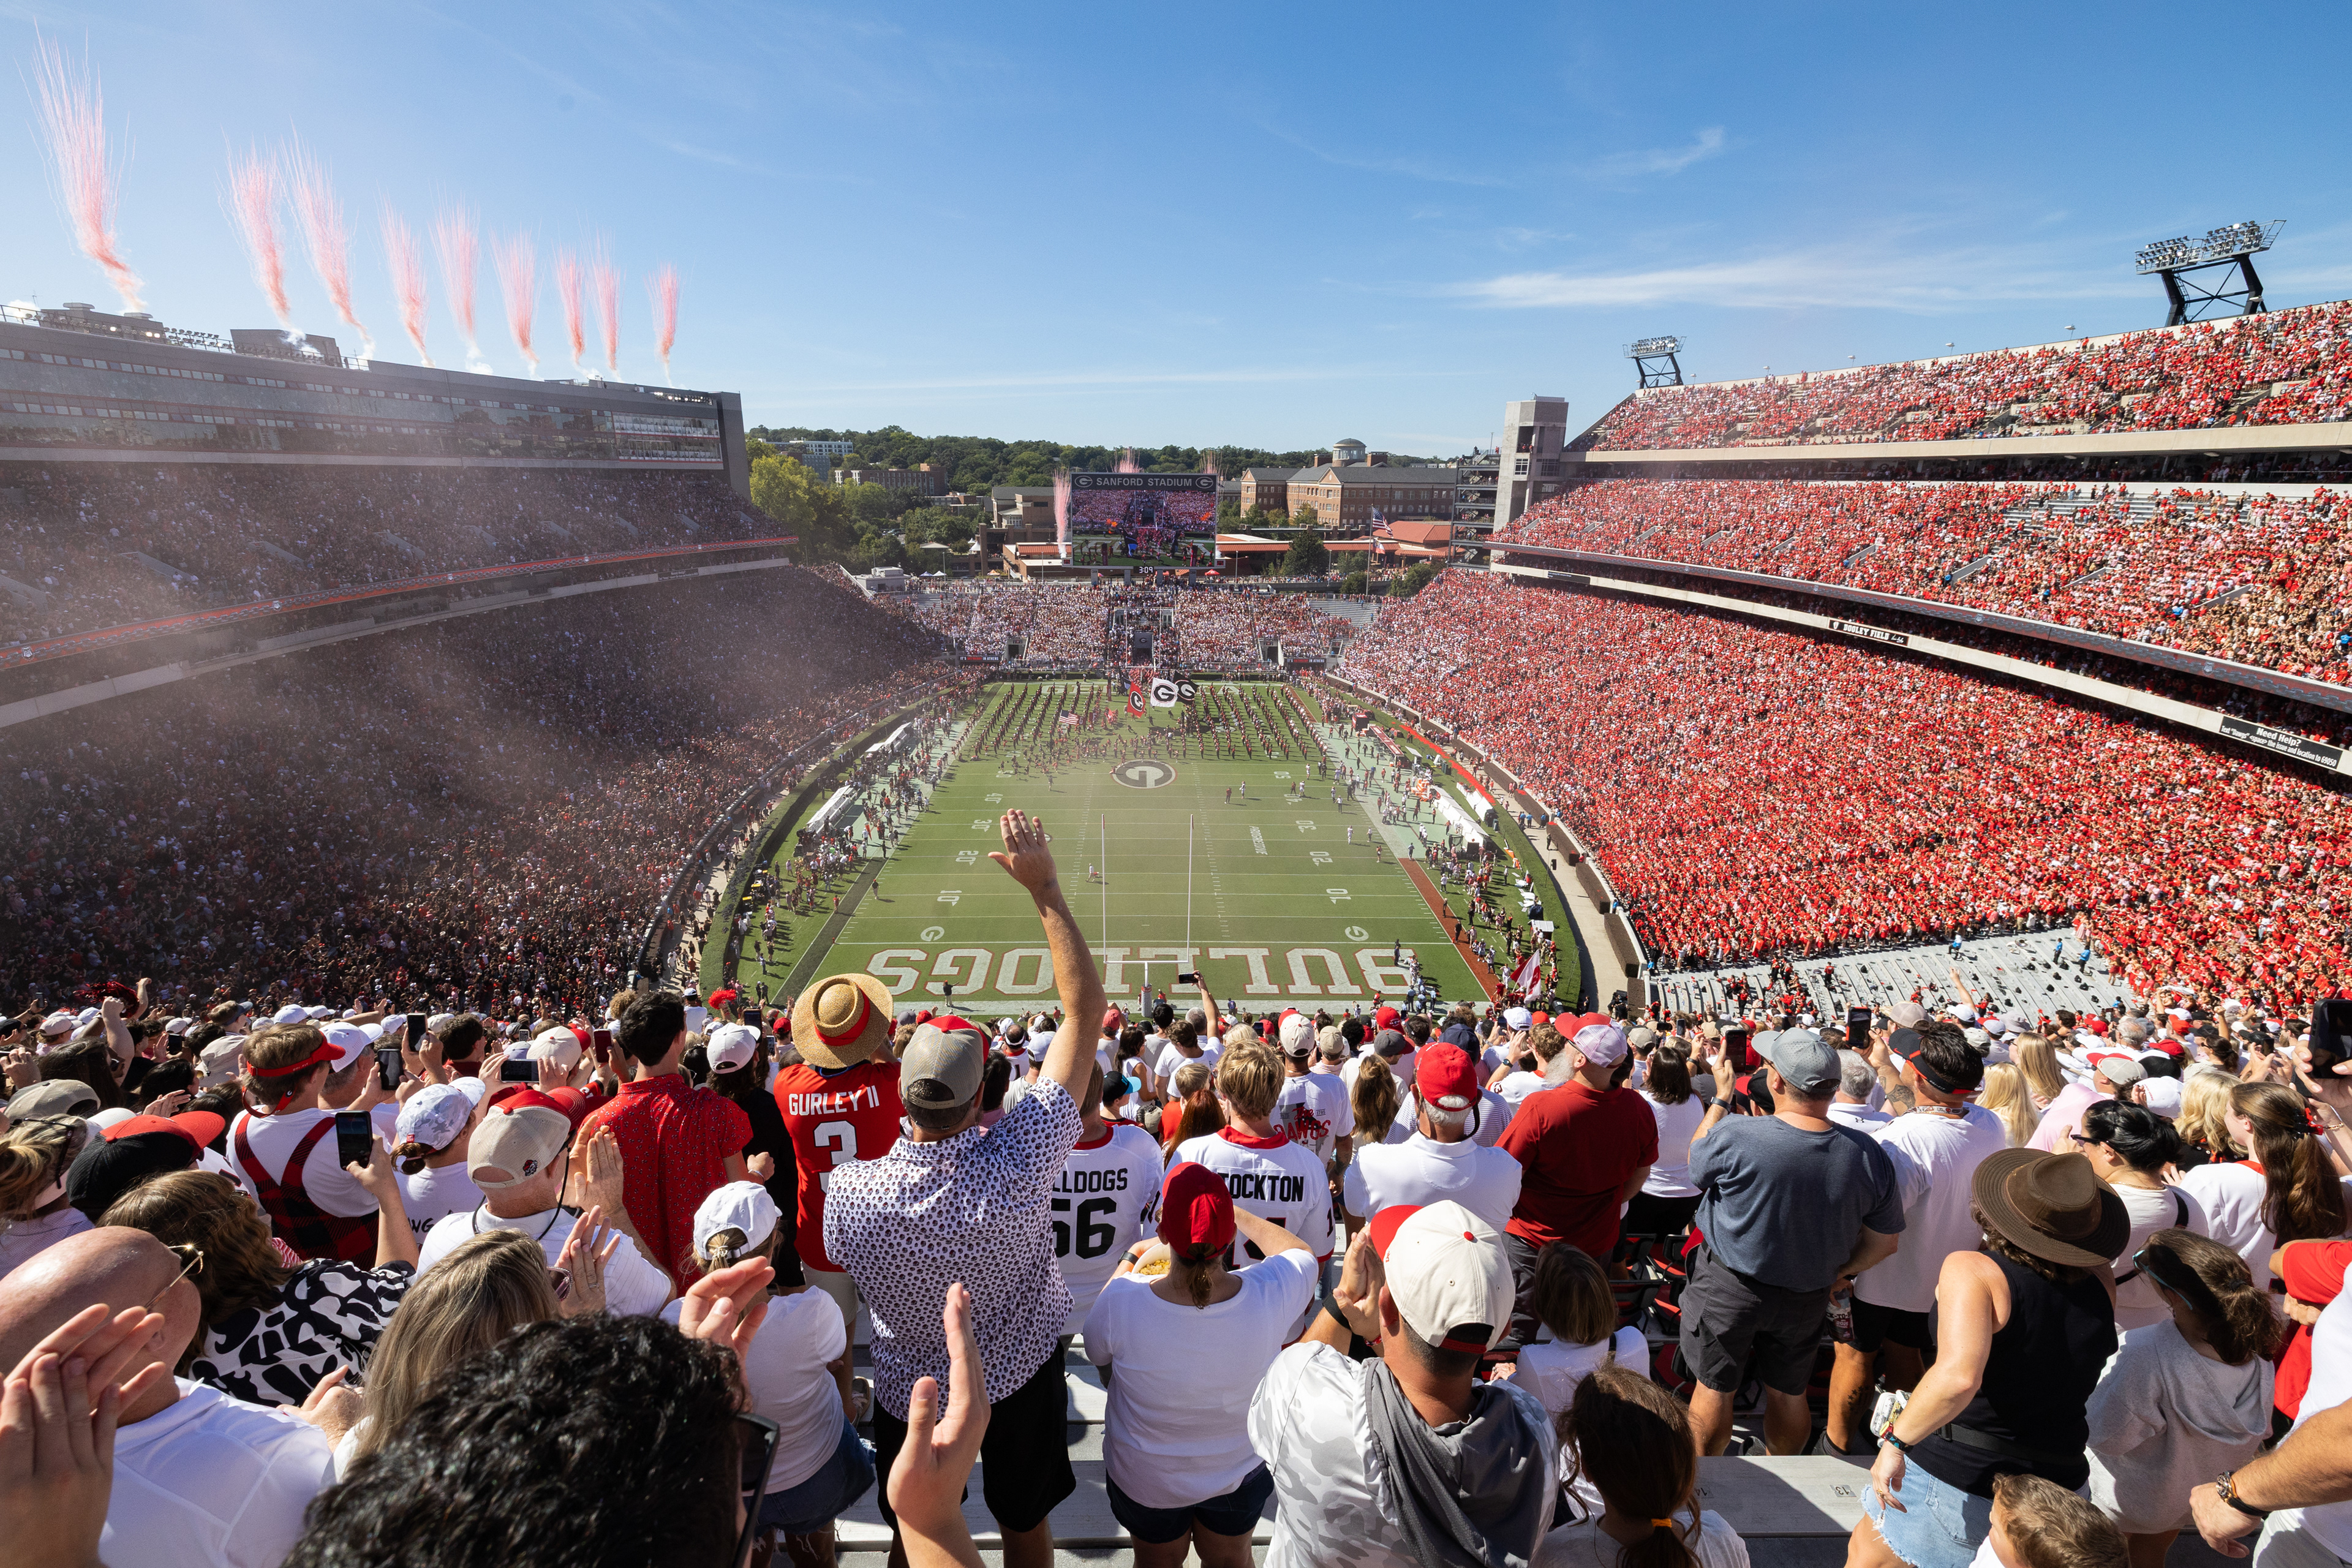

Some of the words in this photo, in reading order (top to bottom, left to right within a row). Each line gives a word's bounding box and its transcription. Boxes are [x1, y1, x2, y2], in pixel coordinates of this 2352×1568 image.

[1096, 478, 1143, 486] SANFORD
[1148, 478, 1192, 486] STADIUM
[1843, 624, 1869, 635] DOOLEY
[1869, 630, 1890, 640] FIELD
[2256, 727, 2278, 740] Need
[2278, 734, 2302, 747] Help?
[2221, 725, 2231, 734] Text
[2249, 736, 2267, 744] <space>
[2275, 742, 2288, 751] issue
[2297, 748, 2315, 760] location
[2321, 756, 2337, 767] 69050
[984, 793, 1003, 801] 40
[971, 819, 992, 829] 30
[1295, 820, 1317, 831] 30
[1249, 825, 1268, 855] PROGRESSIVE
[956, 850, 979, 863] 20
[1310, 851, 1333, 863] 20
[937, 890, 962, 902] 10
[1325, 888, 1352, 900] 10
[920, 925, 945, 942] G
[1344, 925, 1370, 941] G
[788, 1090, 862, 1116] GURLEY
[867, 1085, 880, 1109] II
[1292, 1106, 1314, 1120] The
[1273, 1120, 1331, 1141] DAWGS
[1052, 1197, 1117, 1260] 56
[1835, 1486, 1849, 1496] 13
